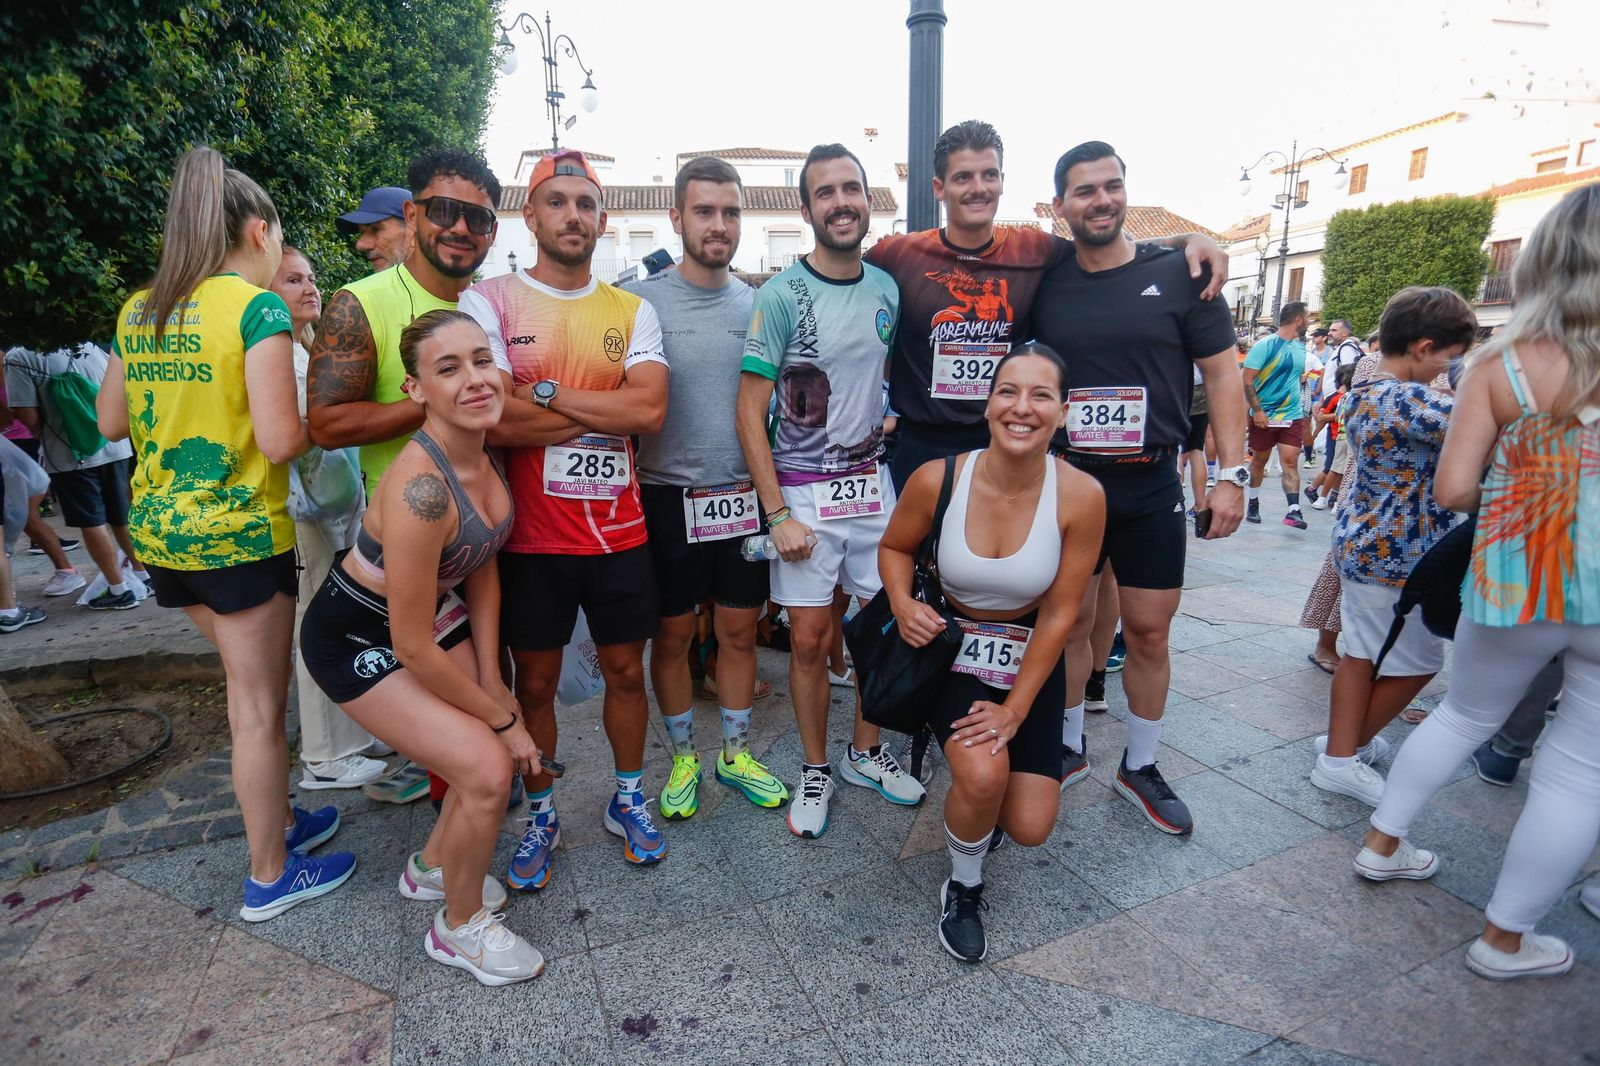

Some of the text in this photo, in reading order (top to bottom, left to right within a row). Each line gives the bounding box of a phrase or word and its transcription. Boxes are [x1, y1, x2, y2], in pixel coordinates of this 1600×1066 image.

[787, 279, 801, 295] LOS
[796, 277, 818, 337] ALCORNOCALES
[929, 321, 1013, 348] ADRENALINE
[605, 337, 622, 353] 9K
[124, 357, 213, 383] ARREÑOS
[951, 359, 994, 380] 392
[945, 385, 976, 393] AVATEL
[1117, 389, 1142, 397] SOLIDARIA
[1080, 404, 1127, 426] 384
[1075, 431, 1107, 439] AVATEL
[565, 452, 616, 479] 285
[559, 482, 596, 493] AVATEL
[829, 478, 868, 502] 237
[703, 497, 745, 521] 403
[828, 505, 857, 514] AVATEL
[700, 524, 732, 534] AVATEL
[957, 621, 979, 630] CARRERA
[963, 638, 1013, 667] 415
[956, 665, 991, 679] AVATEL
